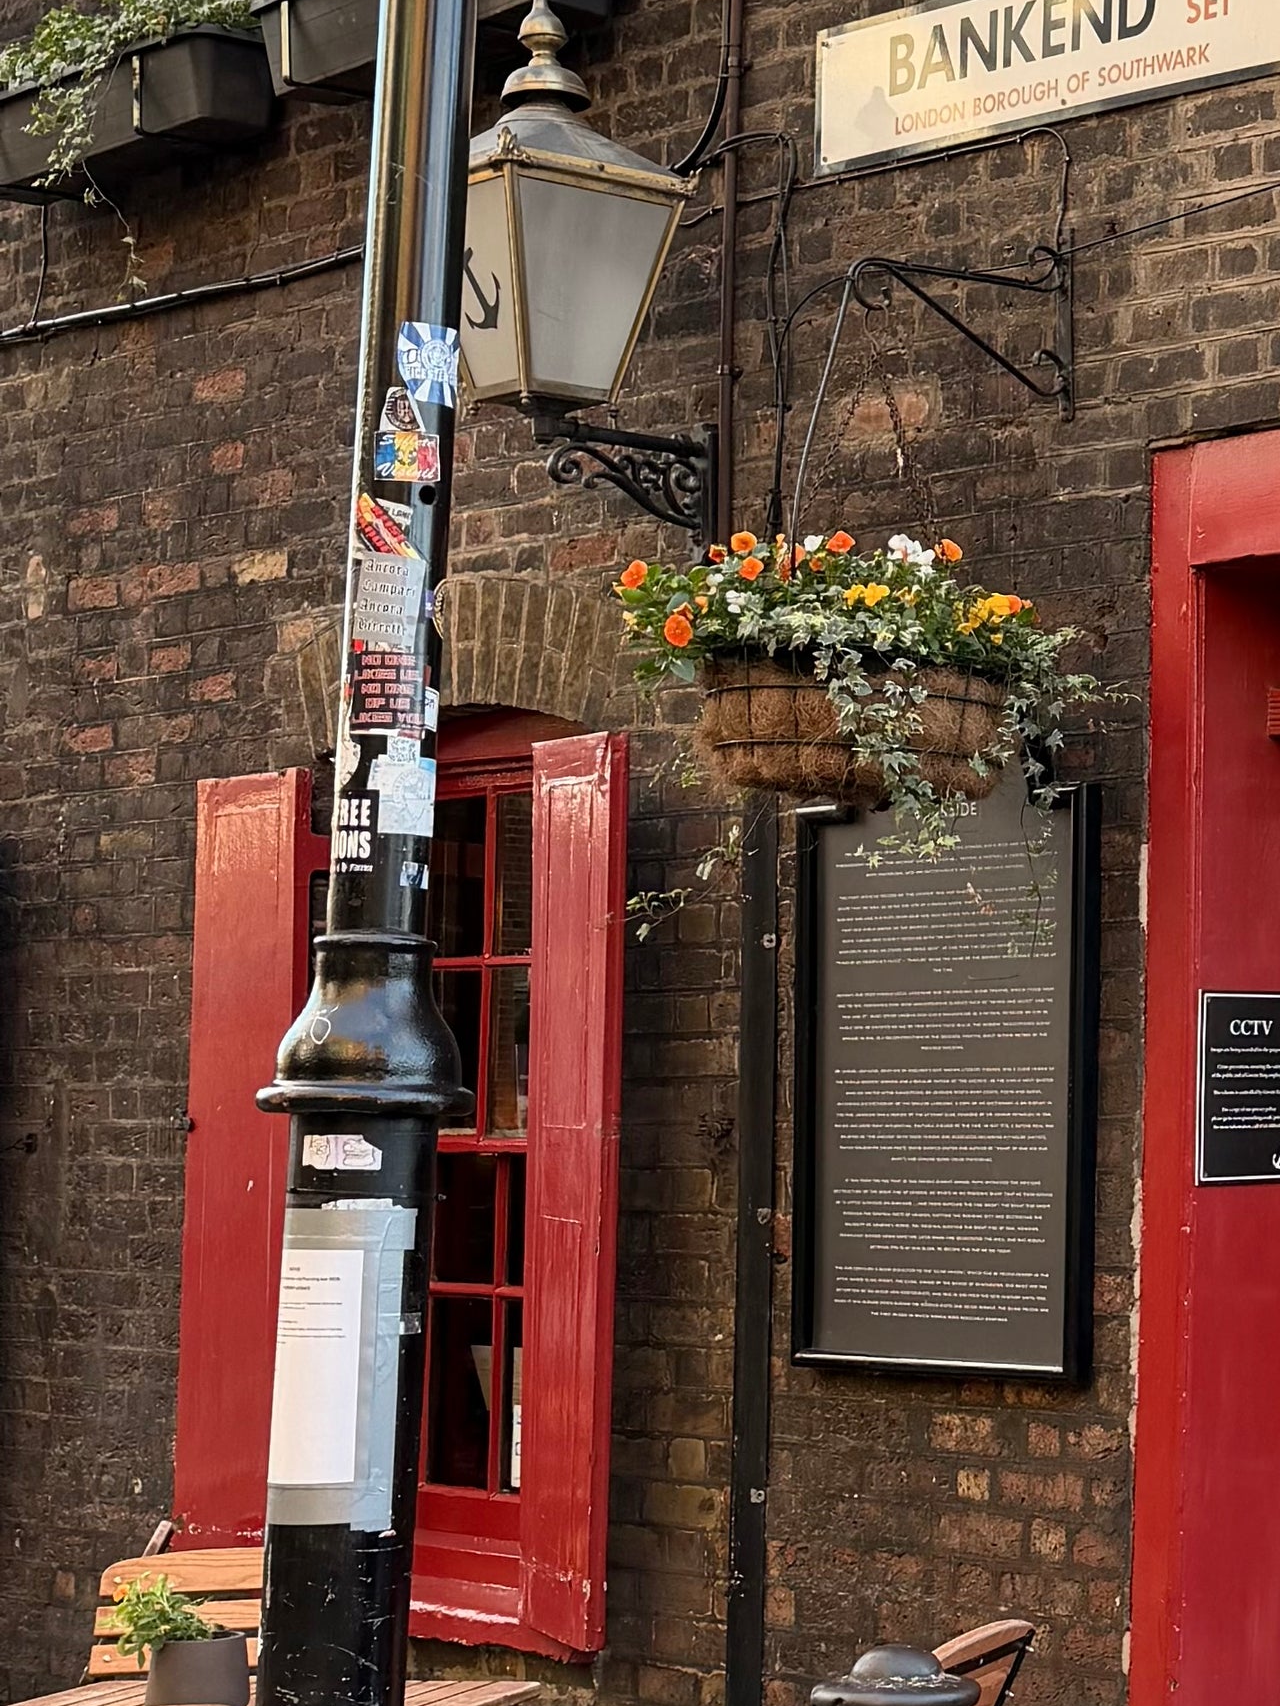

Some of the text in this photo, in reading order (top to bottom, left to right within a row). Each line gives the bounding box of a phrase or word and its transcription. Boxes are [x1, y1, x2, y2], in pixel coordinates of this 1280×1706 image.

[894, 42, 1211, 136] LONDON BOROUGH OF SOUTHWARK
[1229, 1019, 1273, 1036] CCTV
